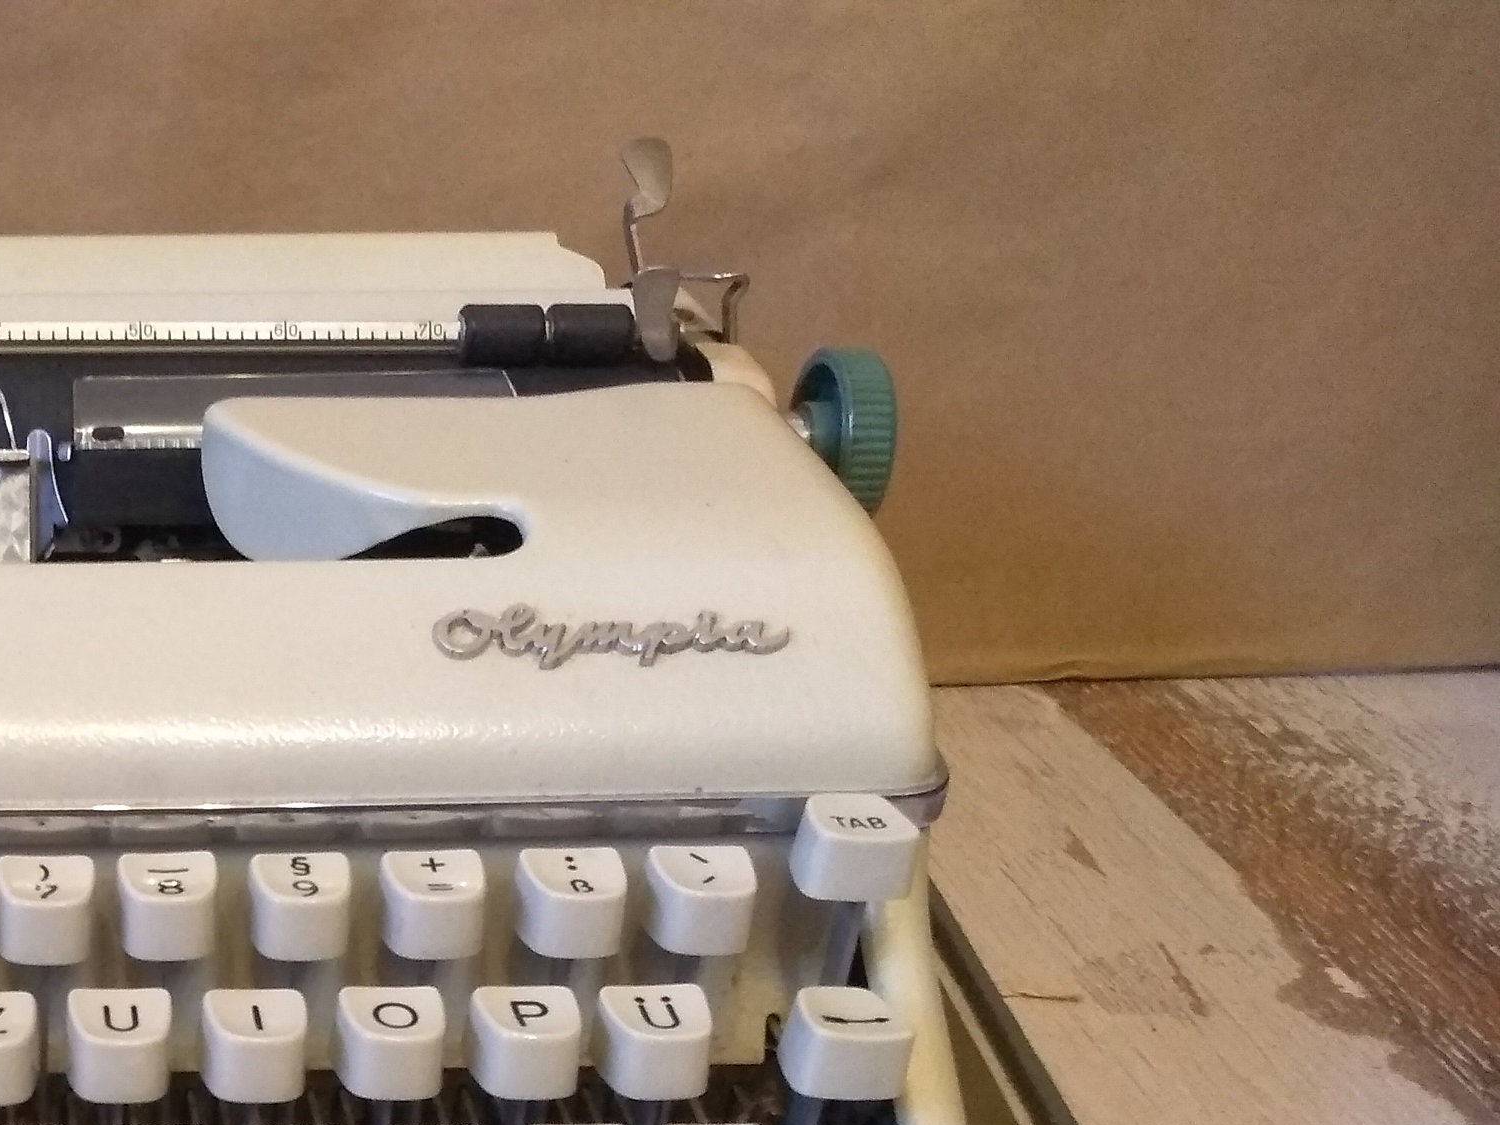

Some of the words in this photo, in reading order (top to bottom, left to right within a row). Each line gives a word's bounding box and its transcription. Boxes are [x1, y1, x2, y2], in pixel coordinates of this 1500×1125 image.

[129, 323, 153, 338] 50
[274, 323, 298, 337] 60
[418, 322, 442, 337] 70
[431, 602, 790, 670] Olympia
[829, 815, 887, 830] TAB
[158, 879, 184, 895] 8
[292, 879, 319, 897] 9
[102, 1004, 140, 1033] U
[251, 1004, 264, 1031] I
[372, 1002, 419, 1029] O
[509, 1000, 549, 1027] P
[633, 995, 681, 1030] Ü
